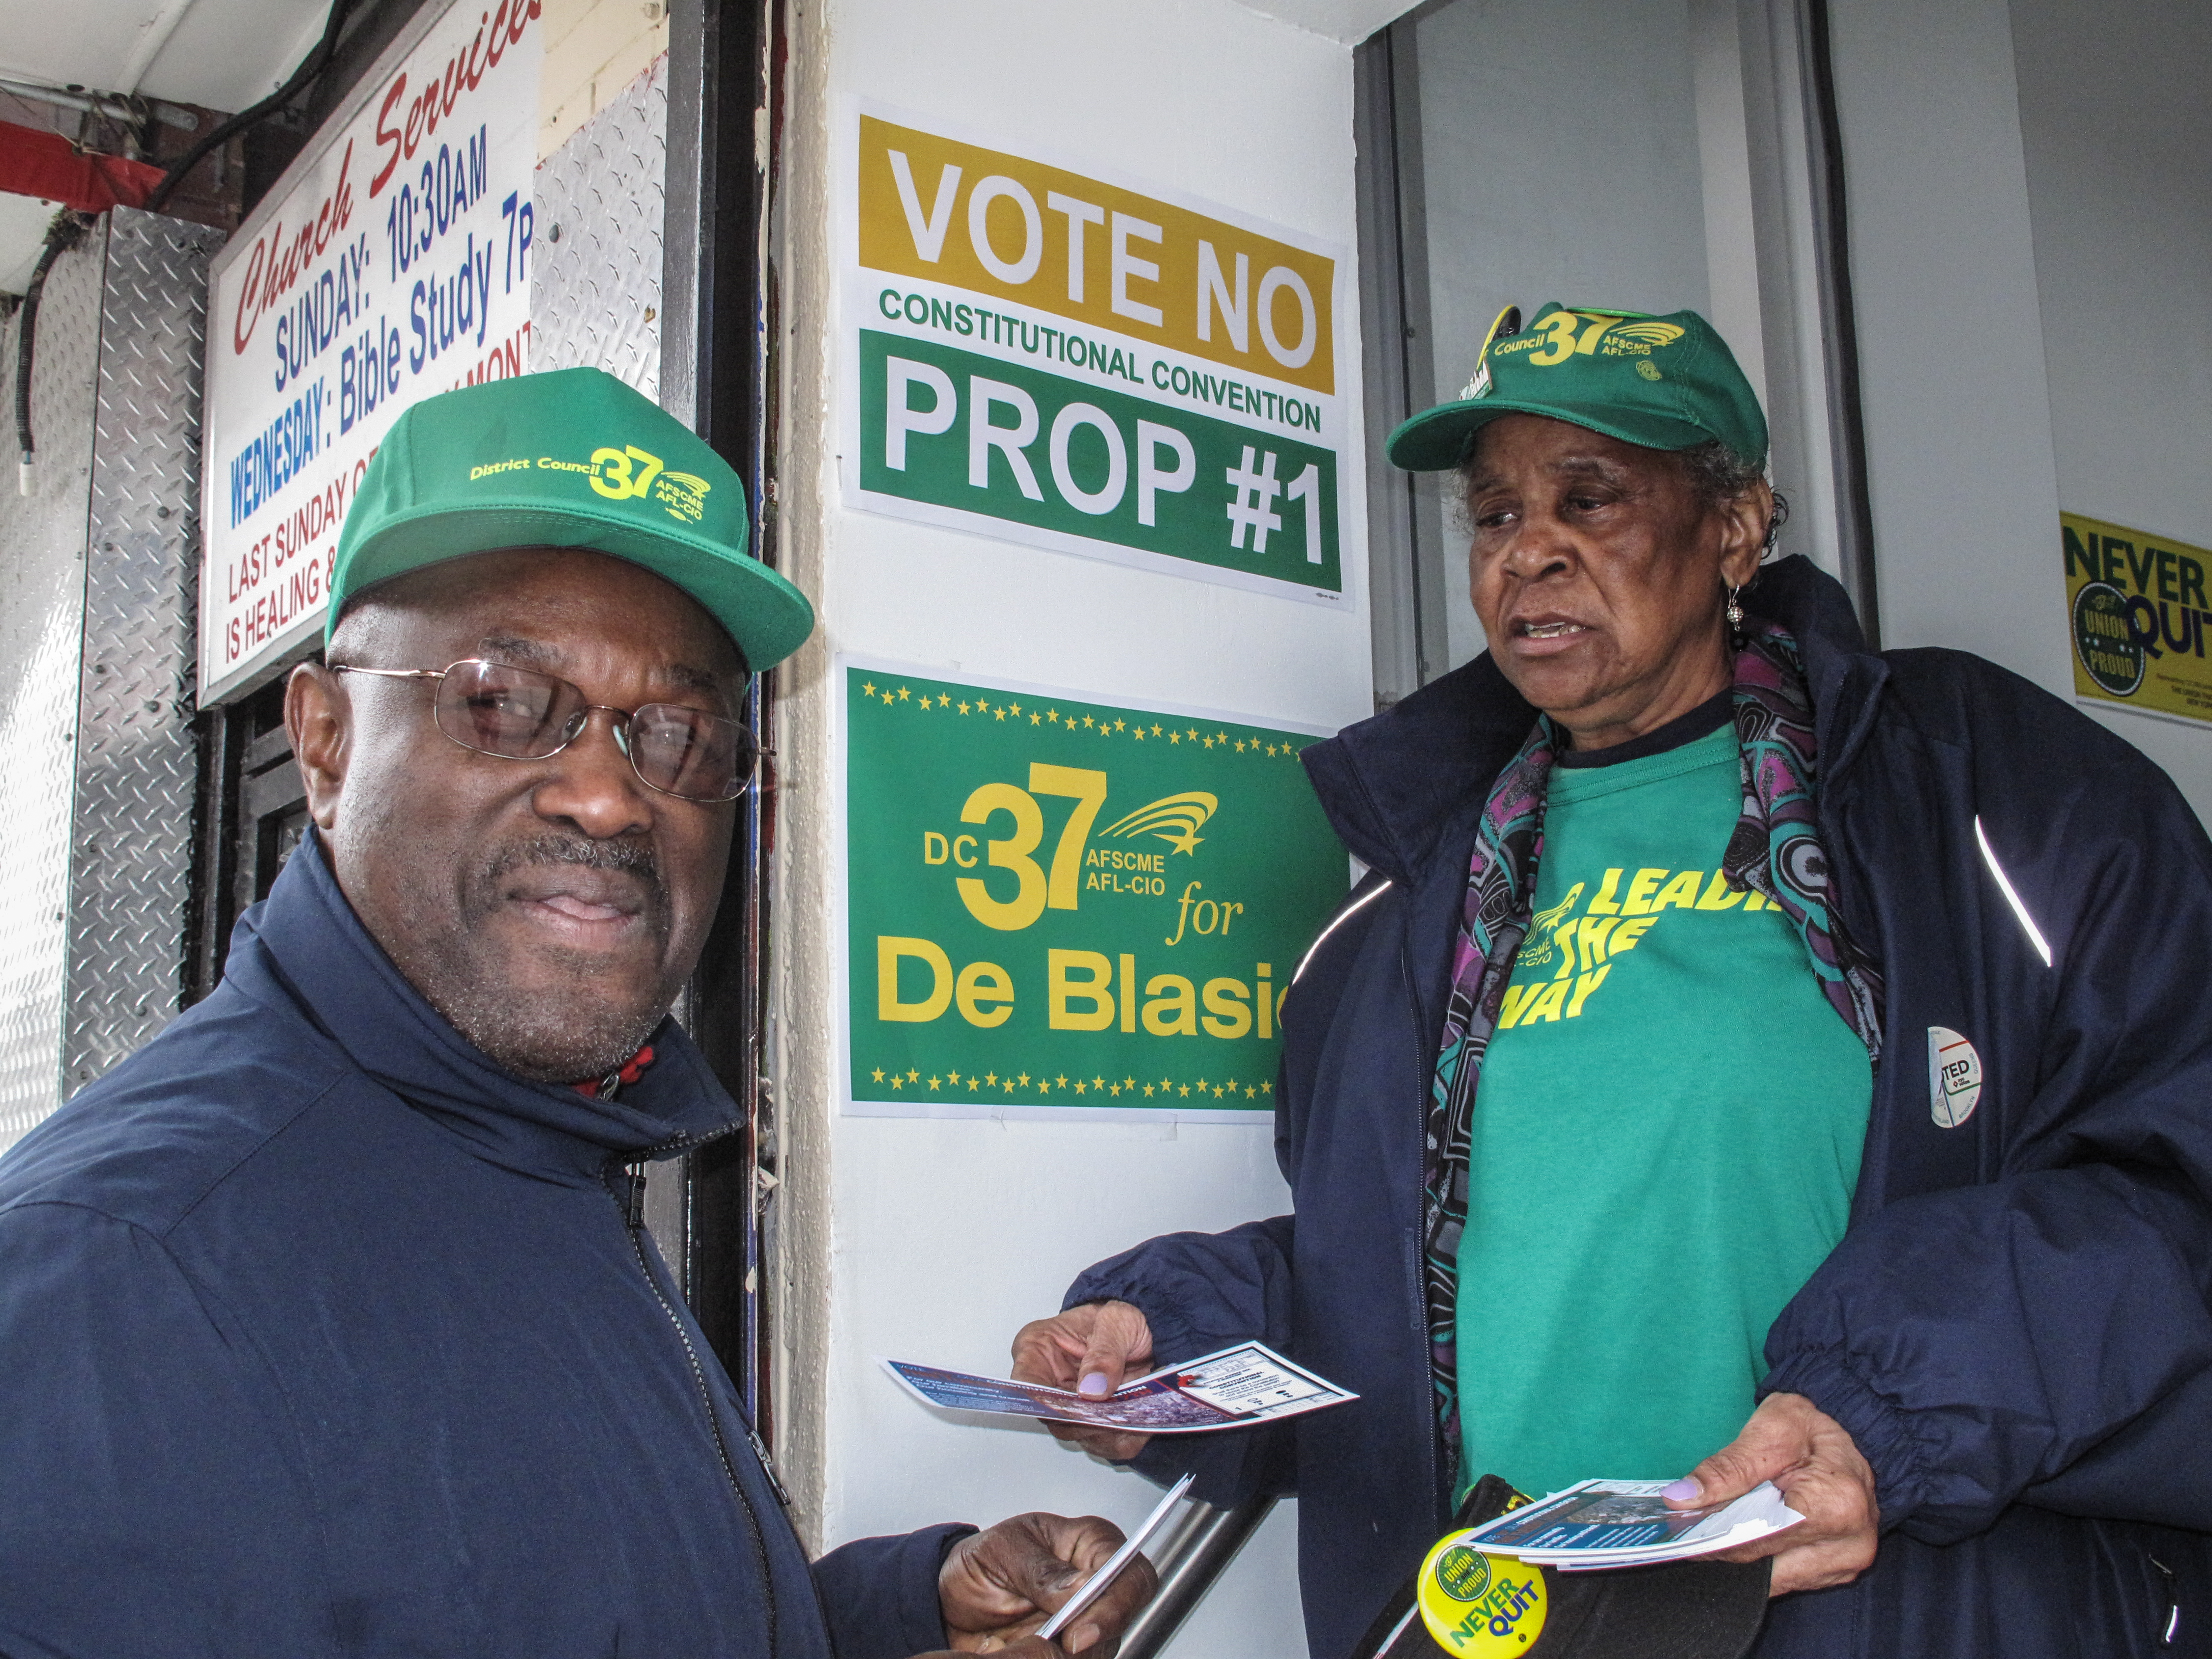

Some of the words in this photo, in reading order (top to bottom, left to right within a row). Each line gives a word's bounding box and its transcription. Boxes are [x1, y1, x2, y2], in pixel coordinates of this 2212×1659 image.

[234, 138, 354, 355] Church
[370, 0, 541, 199] Service
[275, 232, 370, 393] SUNDAY:
[388, 123, 487, 284] 10:30AM
[887, 149, 1164, 328] VOTE
[1197, 239, 1317, 369] NO
[879, 289, 1144, 384] CONSTITUTIONAL
[1152, 360, 1321, 433] CONVENTION
[1494, 333, 1544, 356] Council
[1529, 311, 1624, 366] 37
[1603, 335, 1651, 350] AFSCME
[231, 376, 331, 529] WEDNESDAY:
[340, 315, 401, 437] Bible
[409, 233, 492, 375] Study
[470, 459, 530, 481] District
[537, 457, 601, 476] Council
[589, 445, 664, 500] 37
[886, 354, 1196, 527] PROP
[1225, 445, 1323, 565] #1
[656, 479, 704, 511] AFSCME
[656, 491, 702, 521] AFL-CIO
[230, 539, 270, 604] LAST
[275, 471, 347, 568] SUNDAY
[2063, 525, 2209, 610] NEVER
[226, 620, 240, 664] IS
[246, 558, 319, 651] HEALING
[2085, 609, 2129, 641] UNION
[2090, 649, 2135, 678] PROUD
[924, 831, 978, 868] DC
[956, 761, 1107, 931] 37
[1085, 849, 1165, 873] AFSCME
[1085, 872, 1165, 897] AFL-CIO
[1165, 881, 1244, 947] for
[1517, 936, 1551, 959] SCME
[1553, 916, 1659, 980] THE
[877, 935, 1015, 1029] De
[1048, 948, 1289, 1040] Blasi
[1942, 1059, 1970, 1081] TED
[1444, 1552, 1474, 1582] UNION
[1457, 1568, 1486, 1598] PROUD
[1450, 1578, 1520, 1648] NEVER
[1488, 1579, 1539, 1636] QUIT
